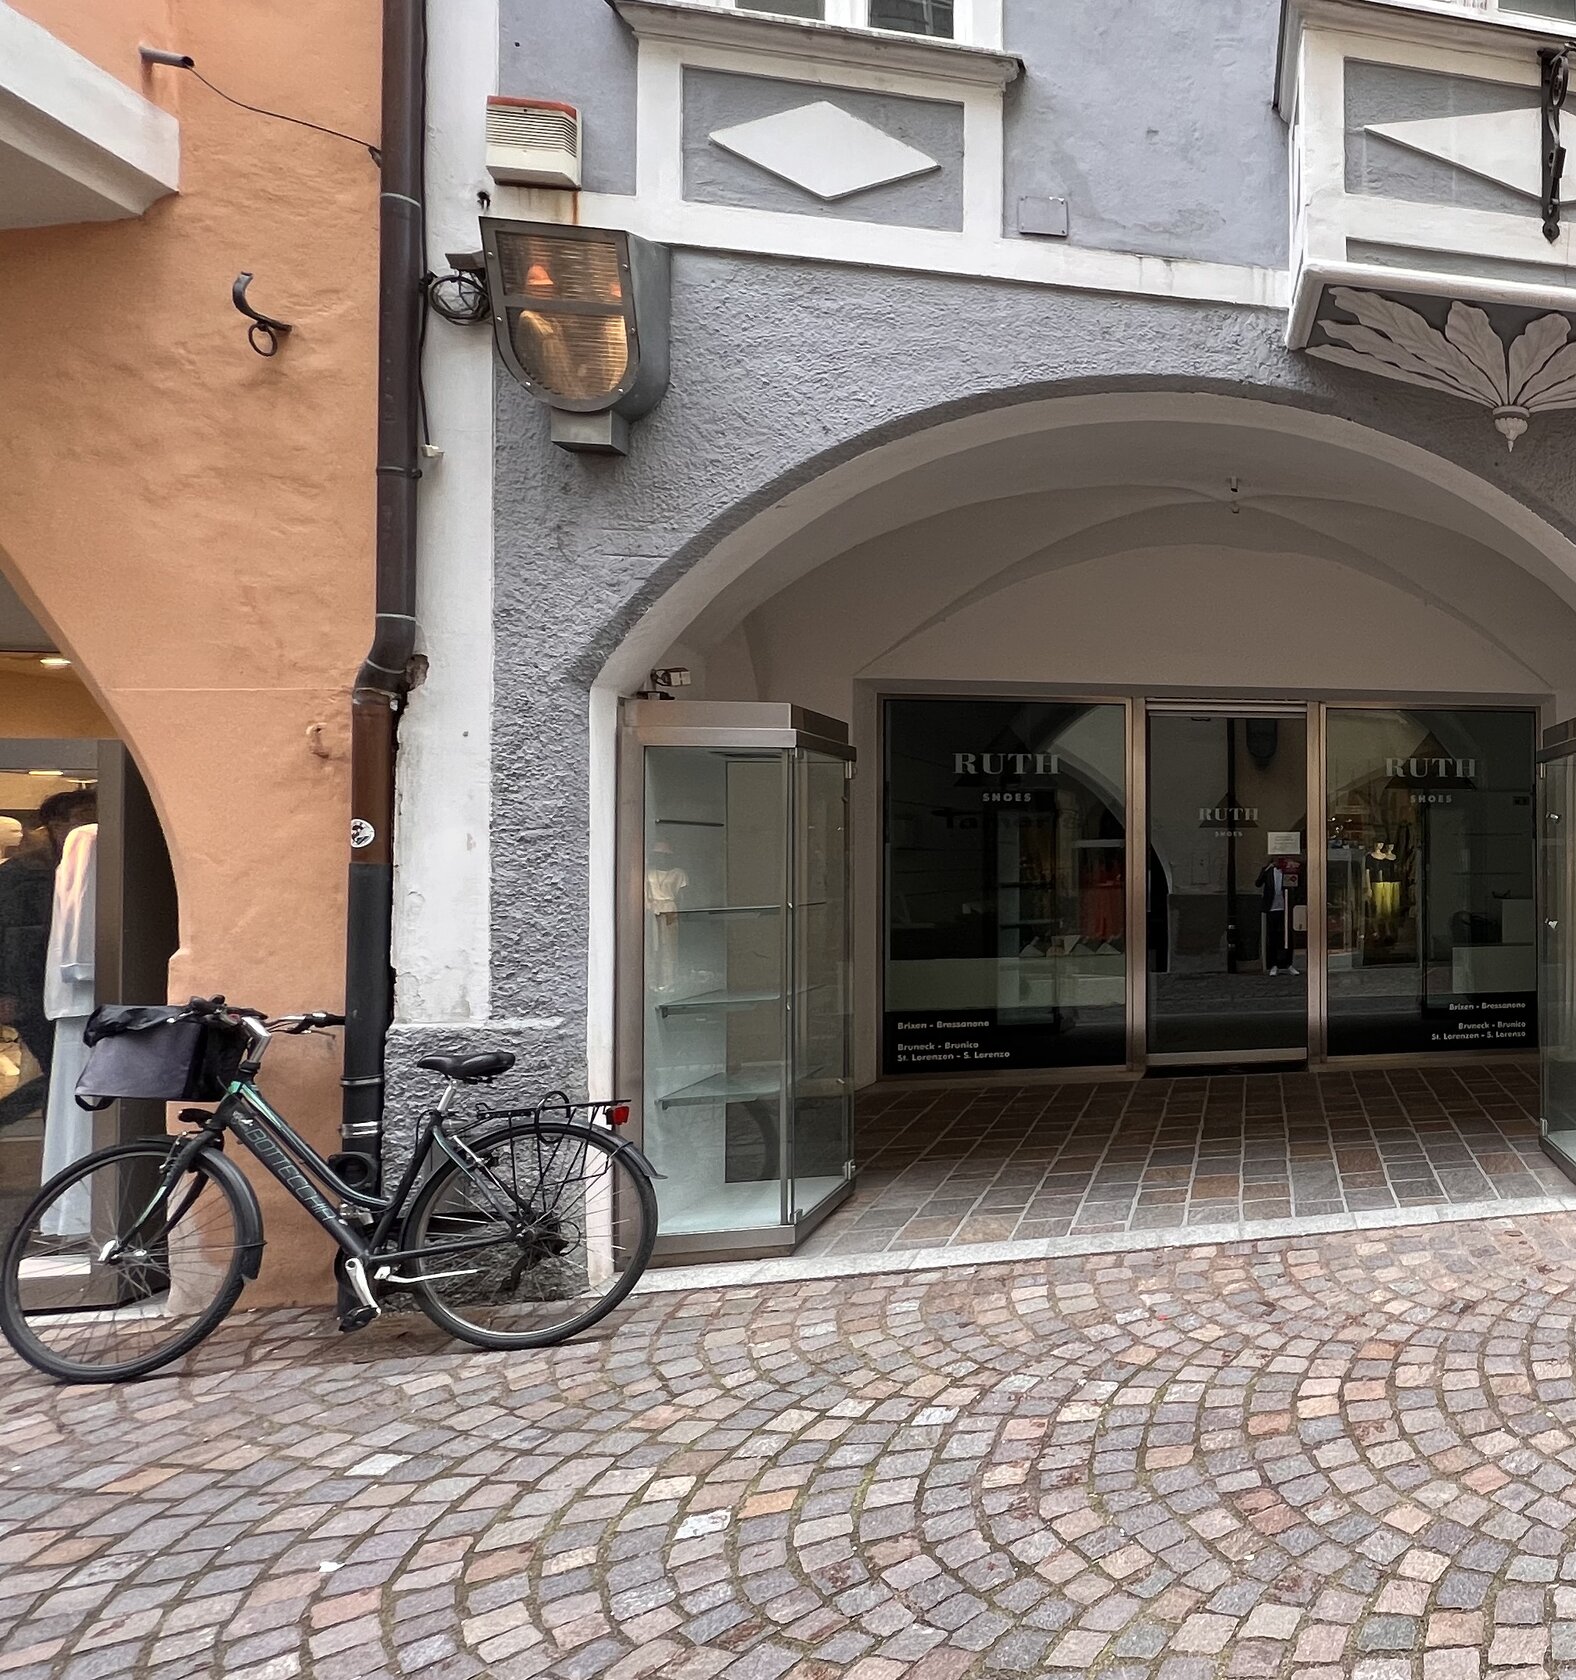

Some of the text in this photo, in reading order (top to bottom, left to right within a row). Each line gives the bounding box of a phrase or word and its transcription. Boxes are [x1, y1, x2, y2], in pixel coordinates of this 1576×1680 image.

[952, 752, 1060, 775] RUTH
[1385, 757, 1477, 778] RUTH
[982, 792, 1031, 802] SHOES
[1410, 794, 1452, 803] SHOES
[1199, 807, 1258, 821] RUTH
[1449, 1003, 1474, 1011] Brixen
[897, 1022, 927, 1030] Brixen
[897, 1042, 935, 1051] Bruneck
[944, 1041, 979, 1050] Brunico
[974, 1051, 1011, 1059] Lorenzo
[244, 1128, 337, 1222] BOTTECCHIA
